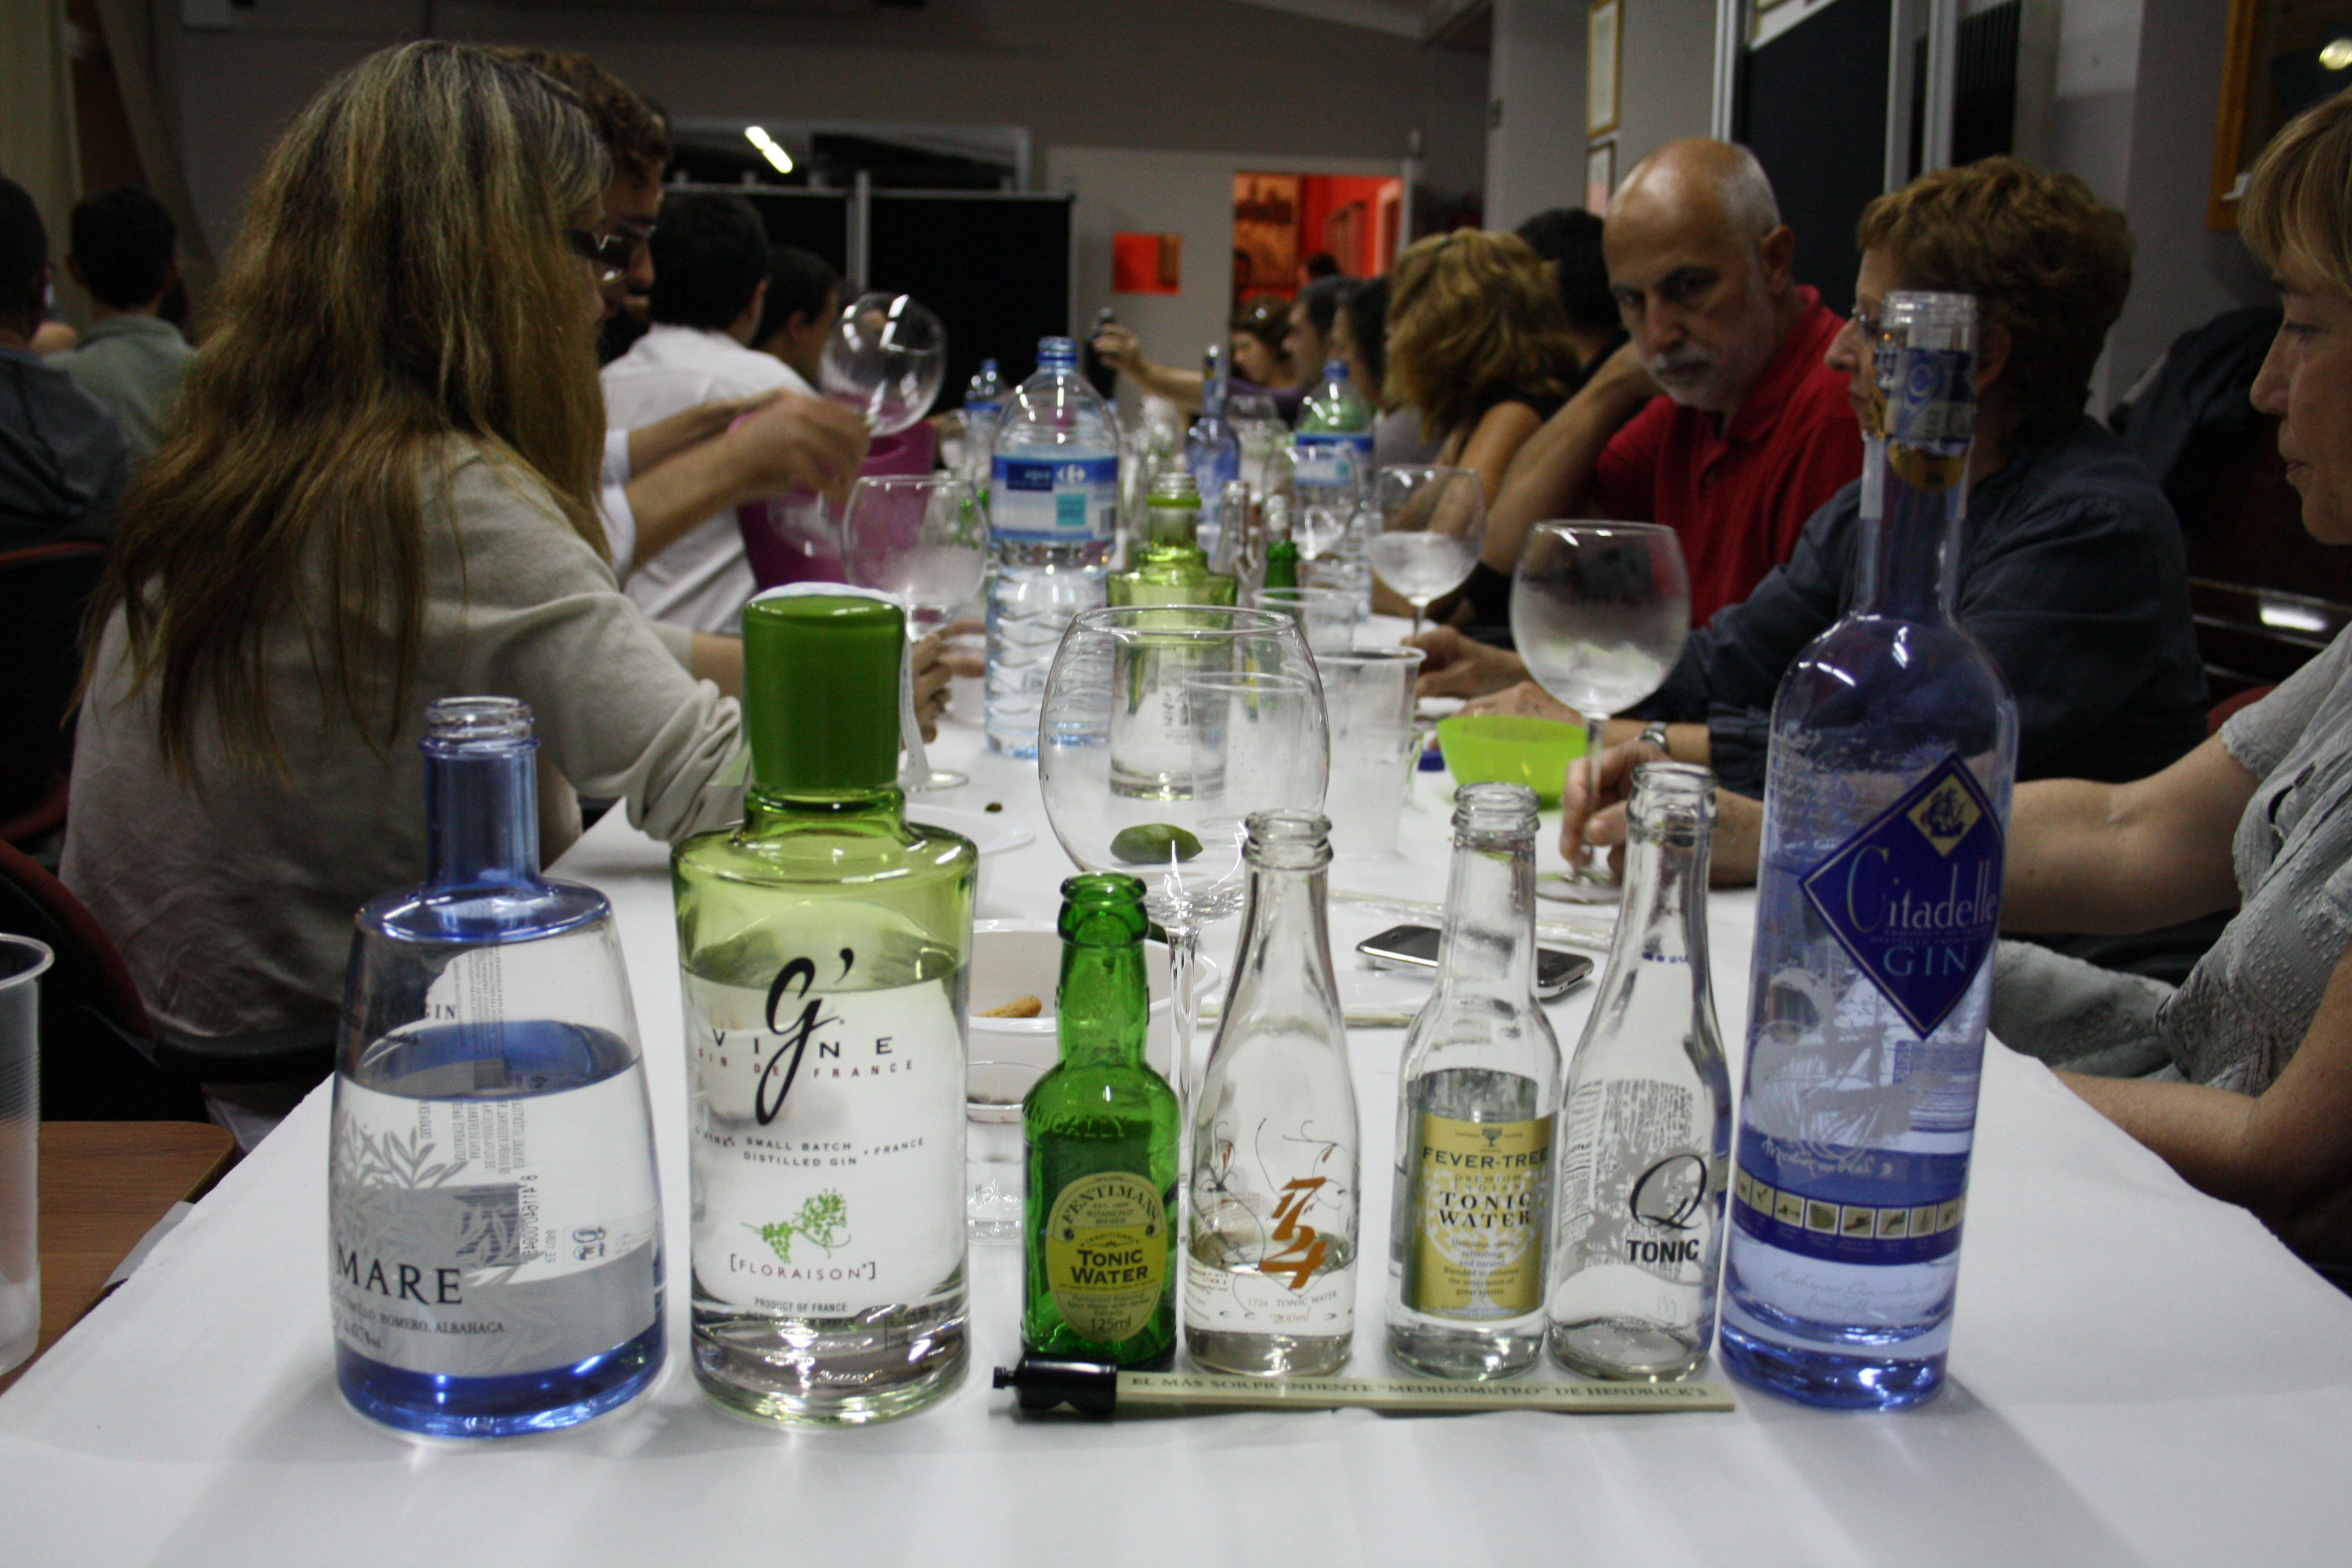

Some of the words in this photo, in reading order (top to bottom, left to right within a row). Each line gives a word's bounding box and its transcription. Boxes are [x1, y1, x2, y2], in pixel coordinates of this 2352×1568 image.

[1847, 845, 1997, 933] Citadelle
[1883, 944, 1968, 976] GIN
[698, 1047, 728, 1067] GIN
[753, 1062, 779, 1077] DE
[813, 1059, 913, 1079] FRANCE
[746, 1136, 793, 1151] SMALL
[802, 1142, 852, 1152] BATCH
[874, 1137, 924, 1156] FRANCE
[743, 1151, 821, 1167] DISTILLED
[829, 1157, 857, 1167] GIN
[1423, 1146, 1549, 1169] FEVER-TREE
[1439, 1191, 1532, 1210] TONIC
[1628, 1153, 1707, 1233] Q
[1439, 1209, 1530, 1229] WATER
[1077, 1249, 1143, 1267] TONIC
[1625, 1238, 1699, 1263] TONIC
[336, 1243, 463, 1306] MARE
[1071, 1266, 1149, 1285] WATER
[754, 1298, 793, 1313] PRODUCT
[797, 1302, 809, 1312] OF
[811, 1302, 847, 1313] FRANCE
[1276, 1298, 1308, 1308] TONIC
[1310, 1290, 1338, 1304] WATER
[436, 1321, 505, 1334] ALBAHACA
[1090, 1315, 1132, 1331] 125ml
[1131, 1377, 1154, 1387] EL
[1210, 1379, 1373, 1393] SORPRNDENTE
[1553, 1386, 1584, 1396] DE
